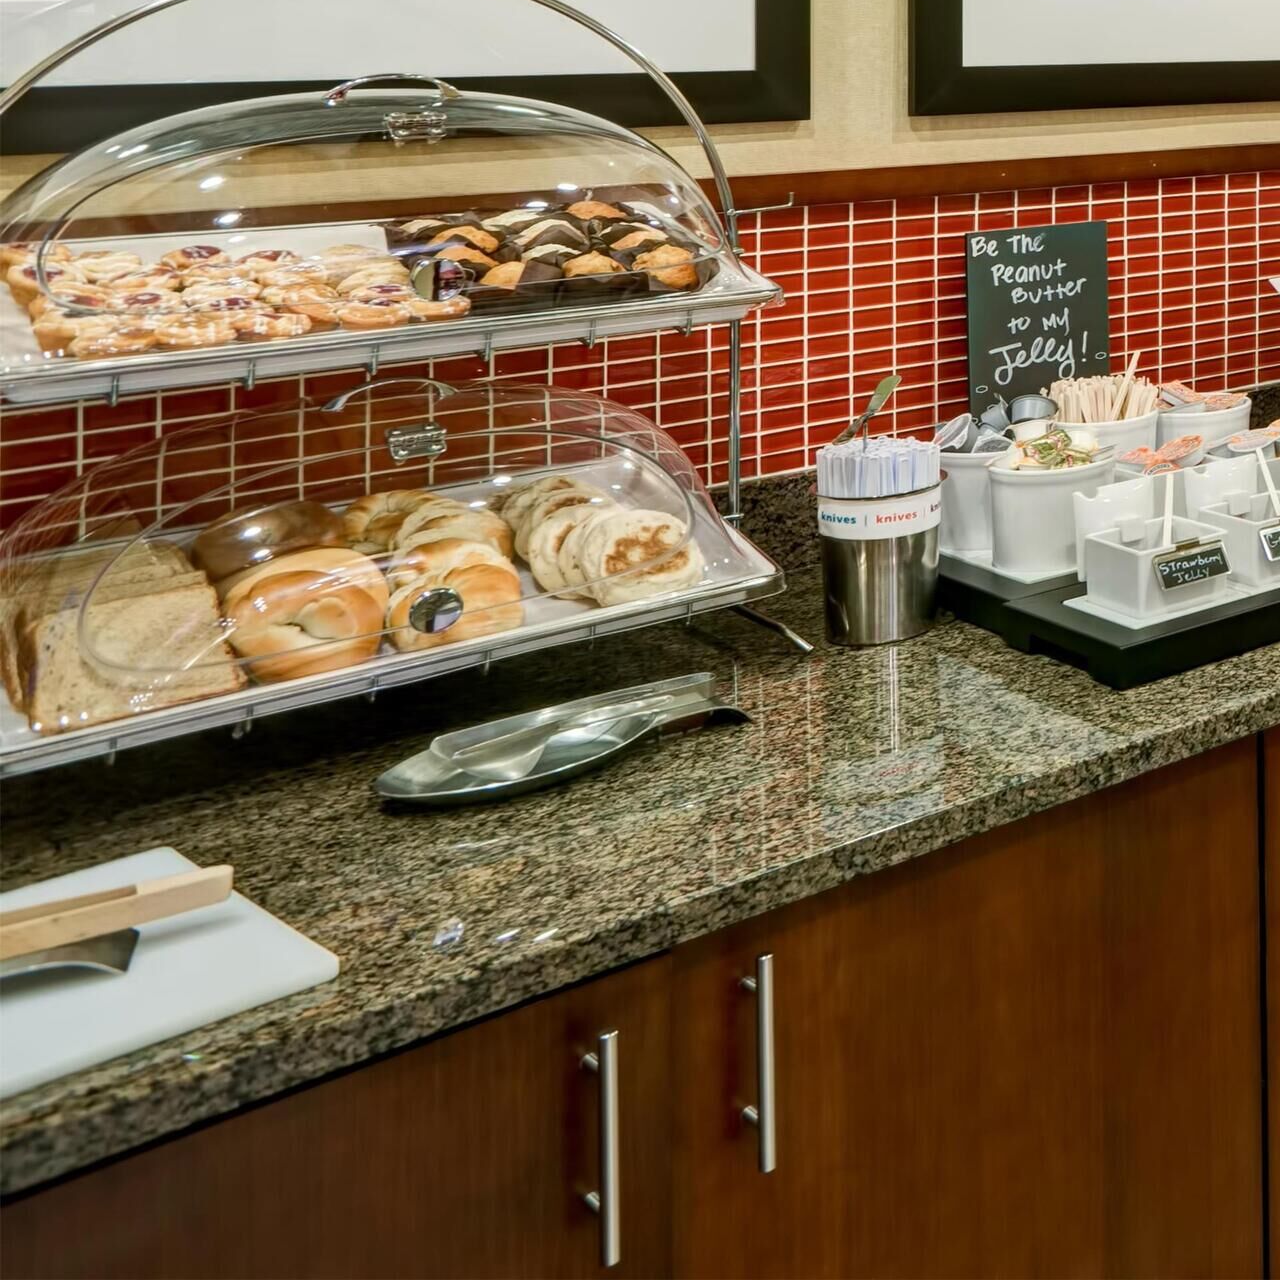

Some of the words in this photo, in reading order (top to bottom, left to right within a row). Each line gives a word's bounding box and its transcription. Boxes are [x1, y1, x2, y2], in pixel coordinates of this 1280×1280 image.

[970, 236, 999, 257] Be
[1006, 233, 1046, 254] The
[990, 258, 1068, 286] Peanut
[1007, 315, 1032, 334] to
[821, 511, 857, 524] knives
[875, 510, 918, 524] knives
